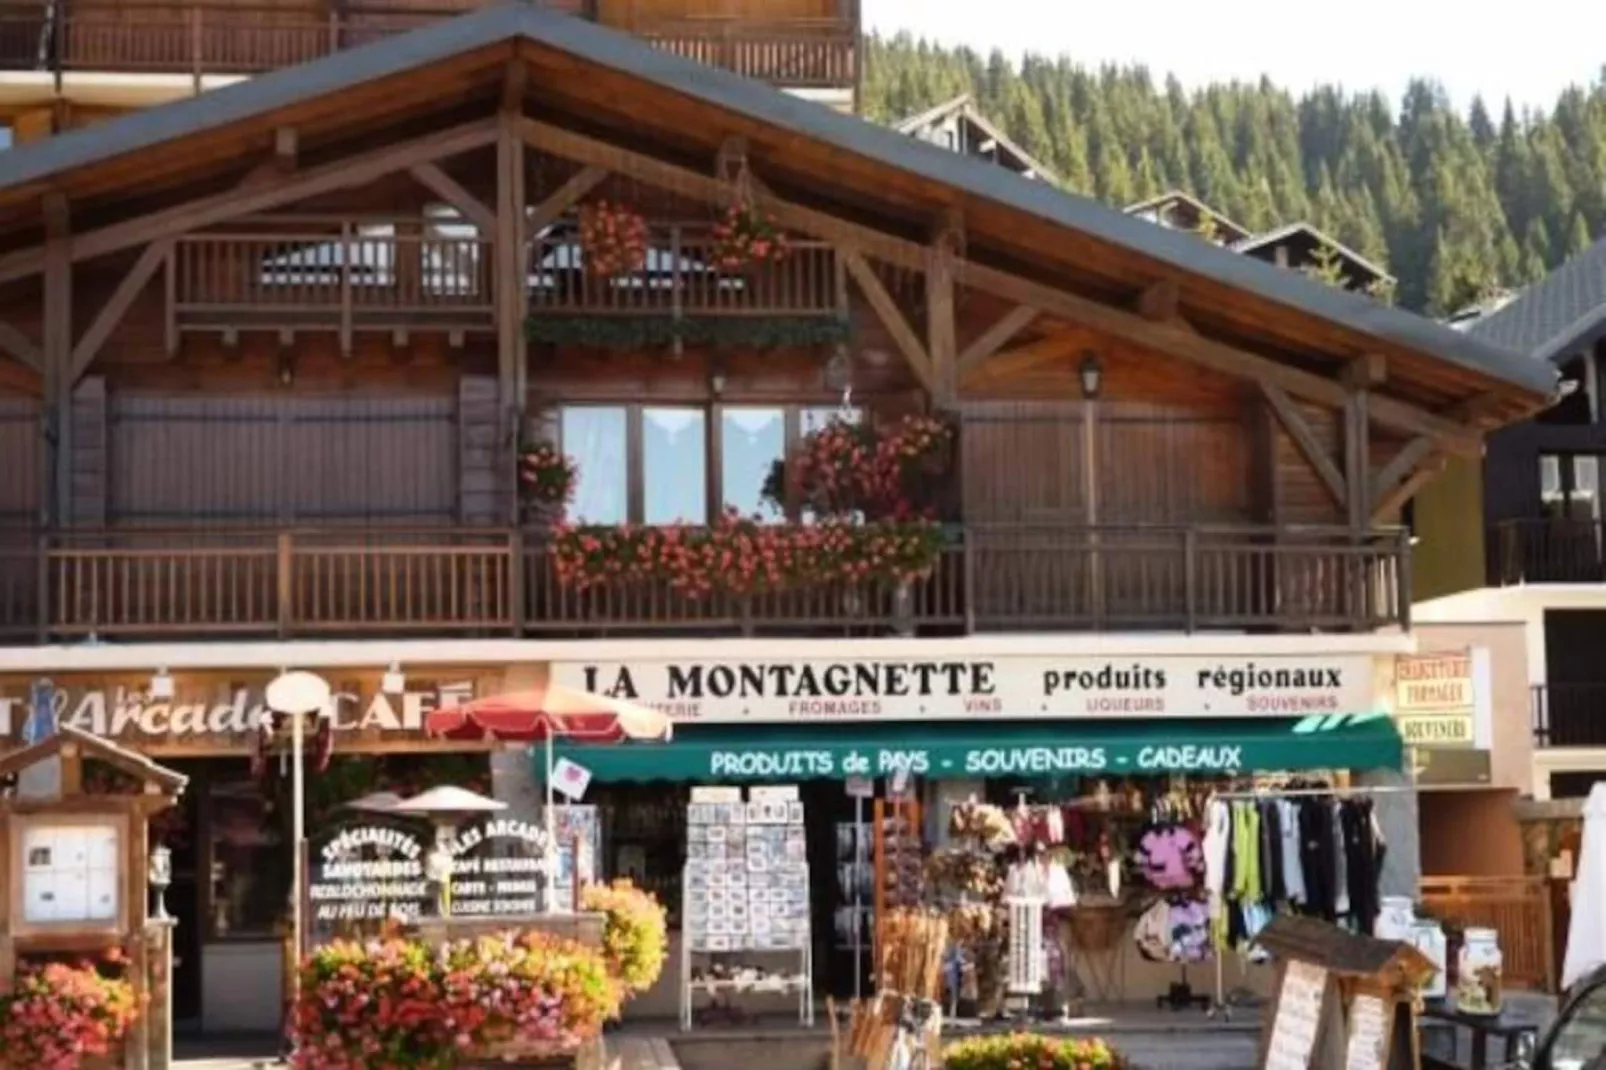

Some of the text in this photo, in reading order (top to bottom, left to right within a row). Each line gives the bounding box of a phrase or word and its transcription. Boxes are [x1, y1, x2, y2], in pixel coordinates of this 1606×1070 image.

[584, 662, 1342, 699] LA MONTAGNETTE produits régionaux
[788, 700, 882, 716] FROMAGES
[963, 698, 1002, 713] VINS
[1086, 697, 1166, 713] LIQUEURS
[1246, 695, 1339, 712] SOUVENIRS
[709, 750, 833, 775] PRODUITS
[842, 749, 871, 774] de
[878, 749, 930, 775] PAYS
[965, 747, 1107, 773] SOUVENIRS
[1136, 745, 1243, 770] CADEAUX
[485, 819, 550, 847] ARCADE
